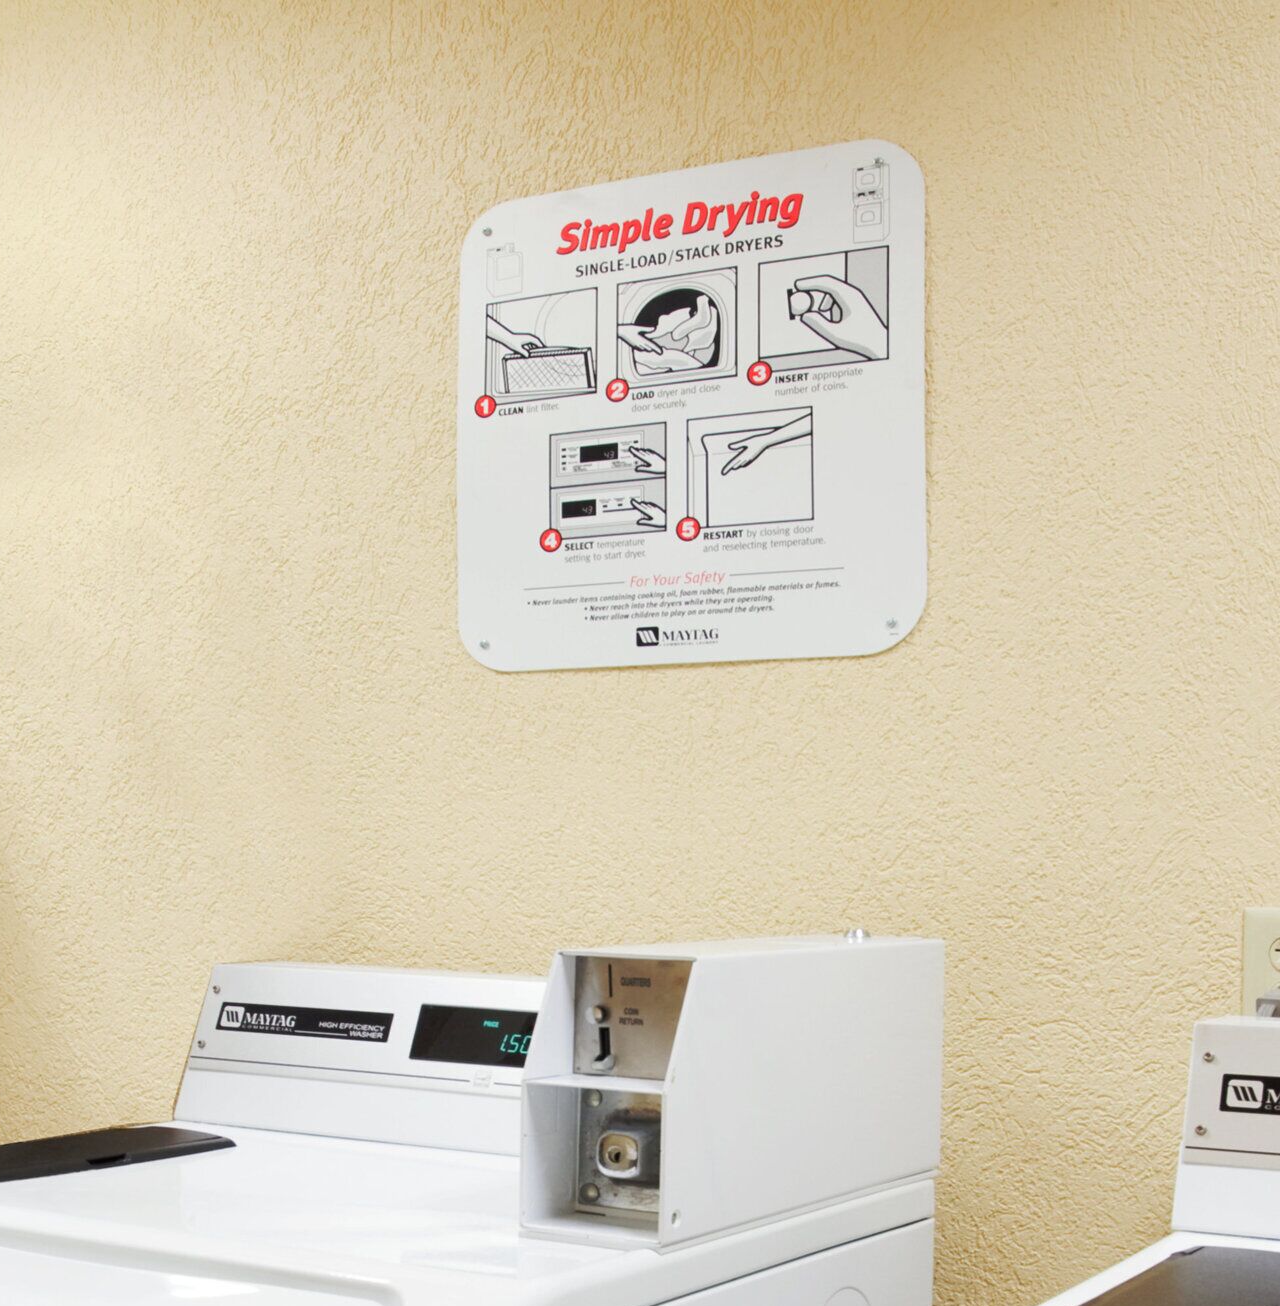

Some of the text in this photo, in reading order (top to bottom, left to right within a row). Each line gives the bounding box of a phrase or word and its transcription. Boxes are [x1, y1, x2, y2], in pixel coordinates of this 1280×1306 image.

[556, 191, 804, 255] Simple Drying
[575, 234, 784, 278] SINGLE-LOAD/STACK DRYERS
[753, 366, 766, 382] 3
[774, 367, 863, 384] INSERT appropriate
[610, 384, 624, 398] 2
[632, 383, 721, 400] LOAD dryer and close
[774, 380, 848, 397] number of coins.
[498, 406, 524, 417] CLEAN
[526, 404, 538, 414] lint
[631, 399, 687, 413] door securely.
[682, 521, 694, 536] 5
[703, 525, 814, 541] RESTART by closing door
[544, 533, 557, 548] 4
[564, 537, 645, 552] SELECT temperature
[703, 535, 826, 553] and reselecting temperature.
[564, 552, 591, 564] setting
[593, 552, 602, 561] to
[604, 550, 622, 561] start
[630, 570, 726, 588] For Your Safety
[637, 591, 665, 600] cooking
[726, 585, 766, 595] flammable
[768, 583, 804, 592] materials
[705, 598, 722, 606] they
[734, 605, 747, 613] the
[662, 628, 719, 641] MAYTAG
[243, 1012, 297, 1028] MAYTAG
[318, 1021, 385, 1032] HIGH EFFICIENCY
[349, 1030, 383, 1039] WASHER
